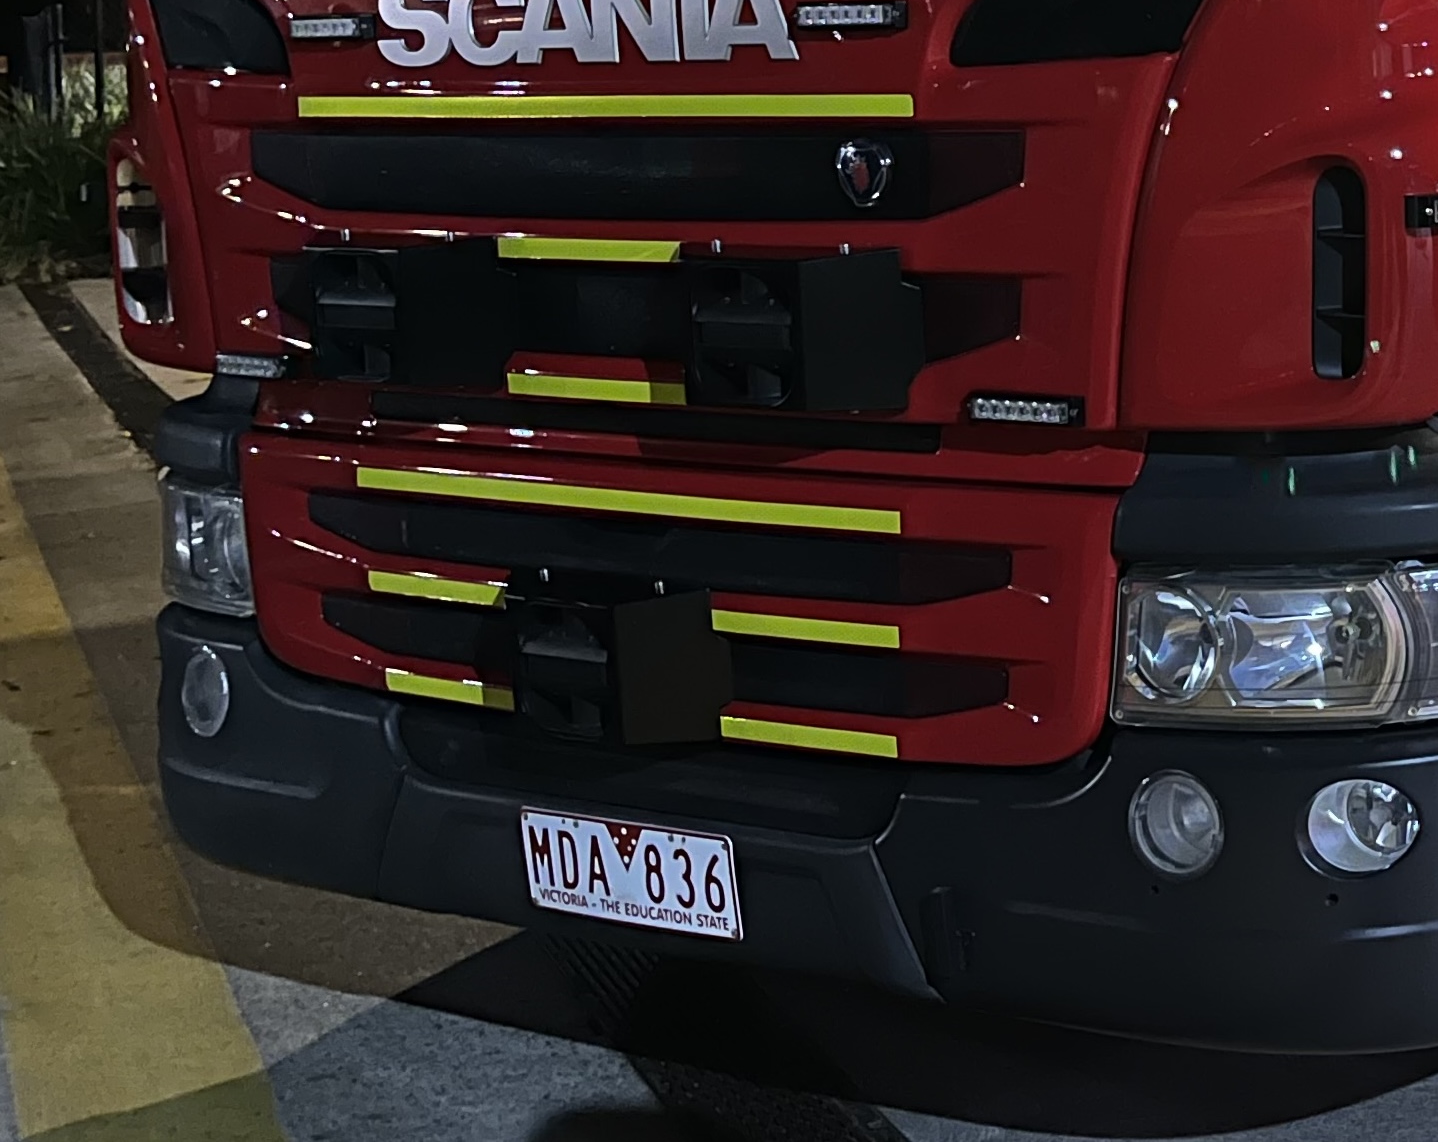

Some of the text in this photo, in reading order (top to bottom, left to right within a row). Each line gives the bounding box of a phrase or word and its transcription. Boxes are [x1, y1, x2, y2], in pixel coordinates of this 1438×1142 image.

[528, 825, 726, 913] MDA 836
[539, 887, 589, 908] VICTORIA
[600, 898, 622, 914] THE
[624, 903, 692, 926] EDUCATION
[697, 914, 729, 931] STATE
